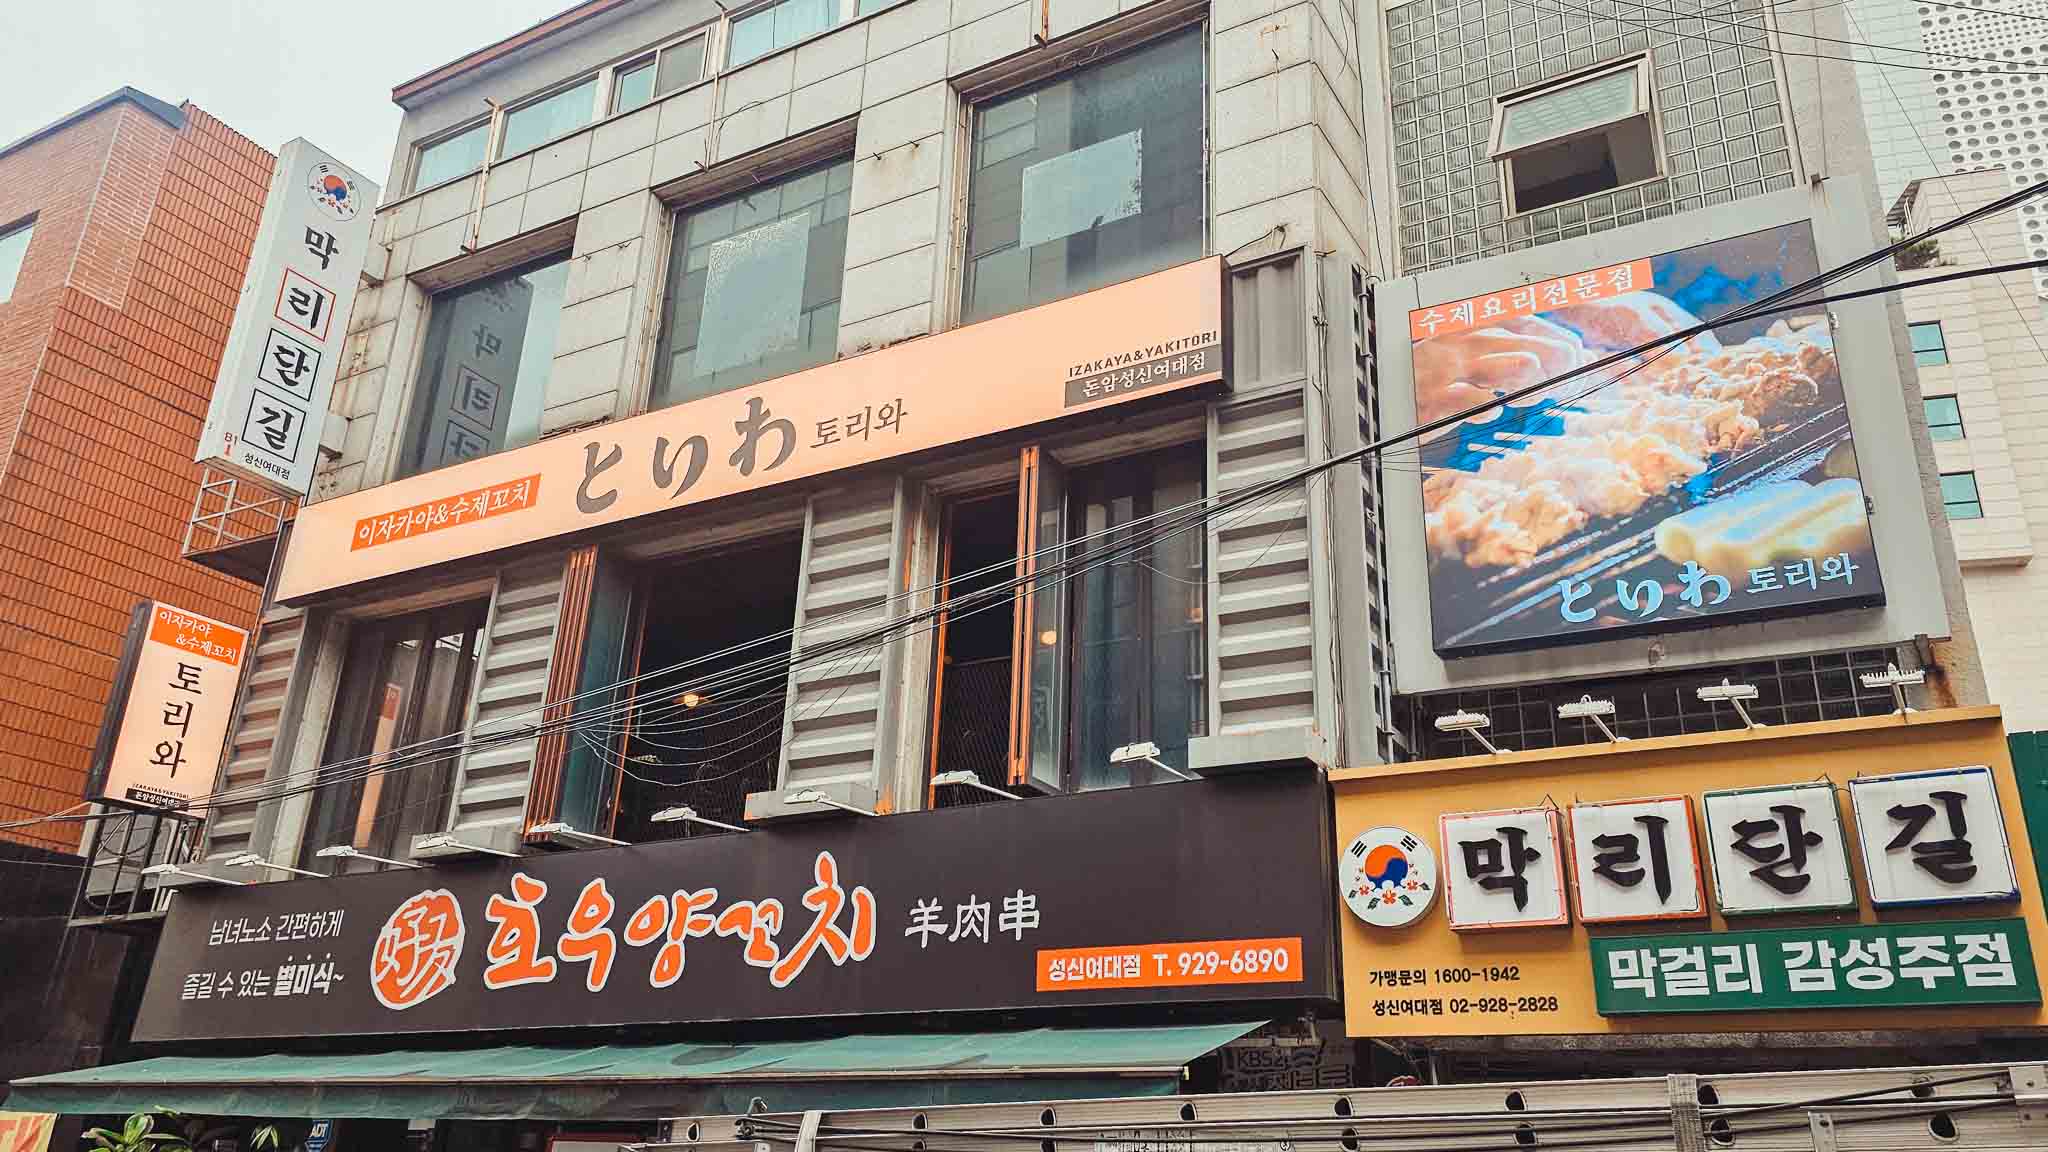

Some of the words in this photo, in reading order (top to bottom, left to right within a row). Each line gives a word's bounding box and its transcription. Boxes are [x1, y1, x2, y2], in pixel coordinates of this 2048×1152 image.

[1418, 264, 1633, 335] 수제요리전문점
[255, 224, 341, 451] 막리단길
[1069, 330, 1217, 378] IZAKAYA&YAKITORI
[1082, 351, 1206, 398] 돈암성신여대점
[809, 398, 909, 449] 토리와
[244, 452, 292, 480] 성신여대점
[358, 479, 531, 545] 이자카야&수제꼬치
[1746, 551, 1860, 595] 토리와
[158, 610, 214, 637] 이자카야
[175, 633, 237, 662] &수제꼬치
[149, 662, 203, 779] 토리와
[1459, 789, 1979, 913] 막리단길
[208, 917, 272, 946] 남녀노소
[275, 909, 344, 941] 간편하게
[483, 850, 877, 993] 호우양꼬치
[904, 888, 1040, 949] 羊肉串
[181, 971, 217, 1000] 즐길
[216, 971, 235, 1000] 수
[237, 969, 271, 998] 있는
[1047, 953, 1142, 983] 성신여대점
[1151, 953, 1172, 978] T.
[1177, 947, 1290, 978] 929-6890
[1369, 967, 1427, 987] 가맹문의
[1434, 965, 1521, 984] 1600-1942
[1606, 942, 1763, 999] 막걸리
[1783, 931, 2017, 993] 감성주점
[1371, 998, 1444, 1017] 성신여대점
[1449, 996, 1559, 1014] 02-928-2828
[308, 1123, 329, 1138] ADT
